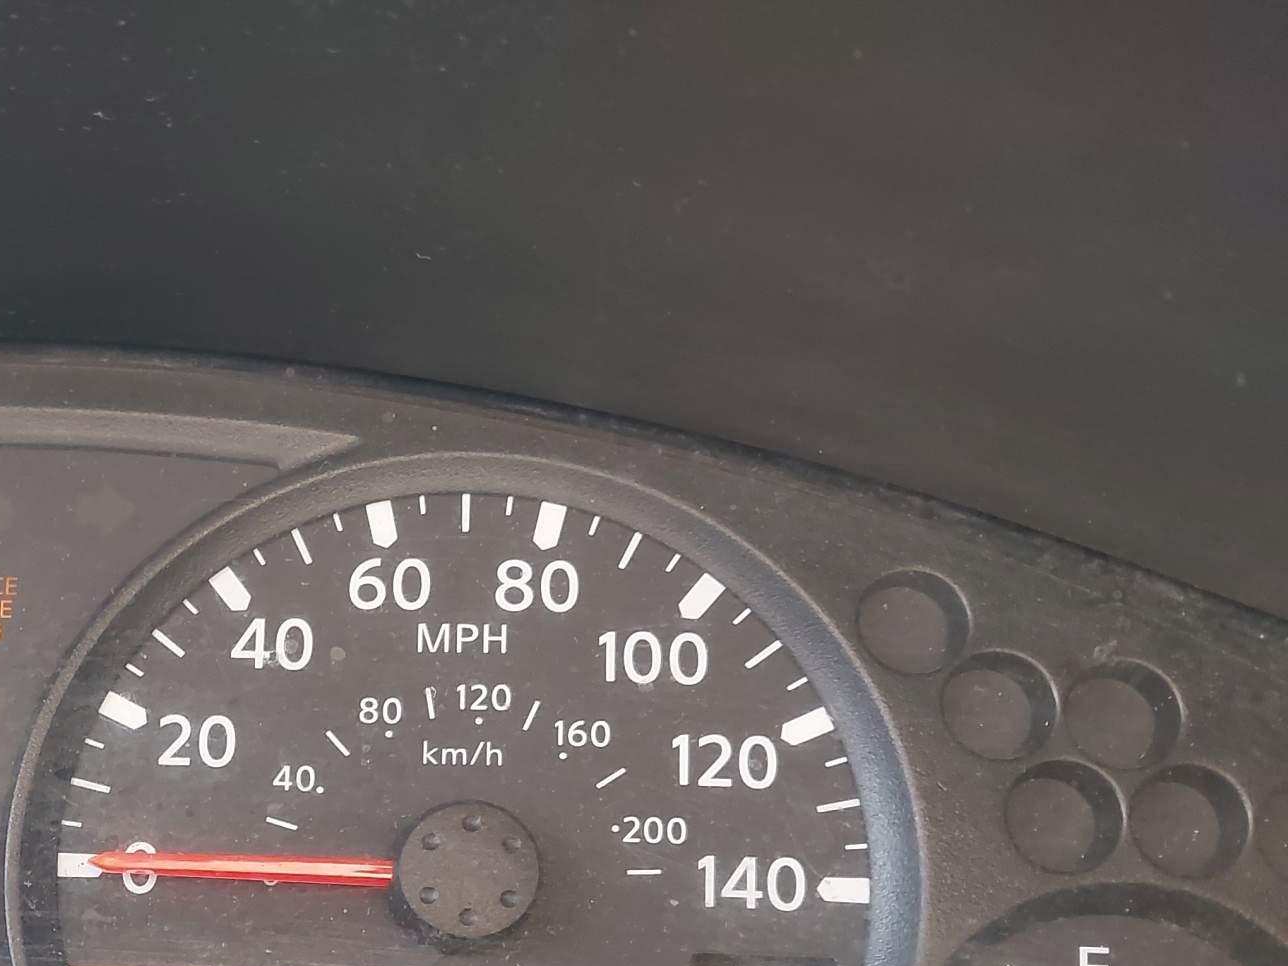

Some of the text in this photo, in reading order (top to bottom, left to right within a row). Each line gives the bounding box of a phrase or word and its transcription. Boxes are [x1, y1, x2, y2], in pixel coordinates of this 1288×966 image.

[349, 558, 430, 610] 60
[496, 560, 578, 612] 80
[231, 618, 312, 670] 40
[418, 624, 507, 653] MPH
[599, 632, 707, 685] 100
[360, 698, 401, 724] 80
[457, 684, 511, 710] 120
[159, 715, 235, 767] 20
[423, 741, 502, 765] km/h
[555, 721, 610, 747] 160
[273, 766, 312, 791] 40
[673, 734, 779, 789] 120
[623, 817, 686, 844] 200
[122, 841, 157, 894] 0
[698, 856, 805, 911] 140
